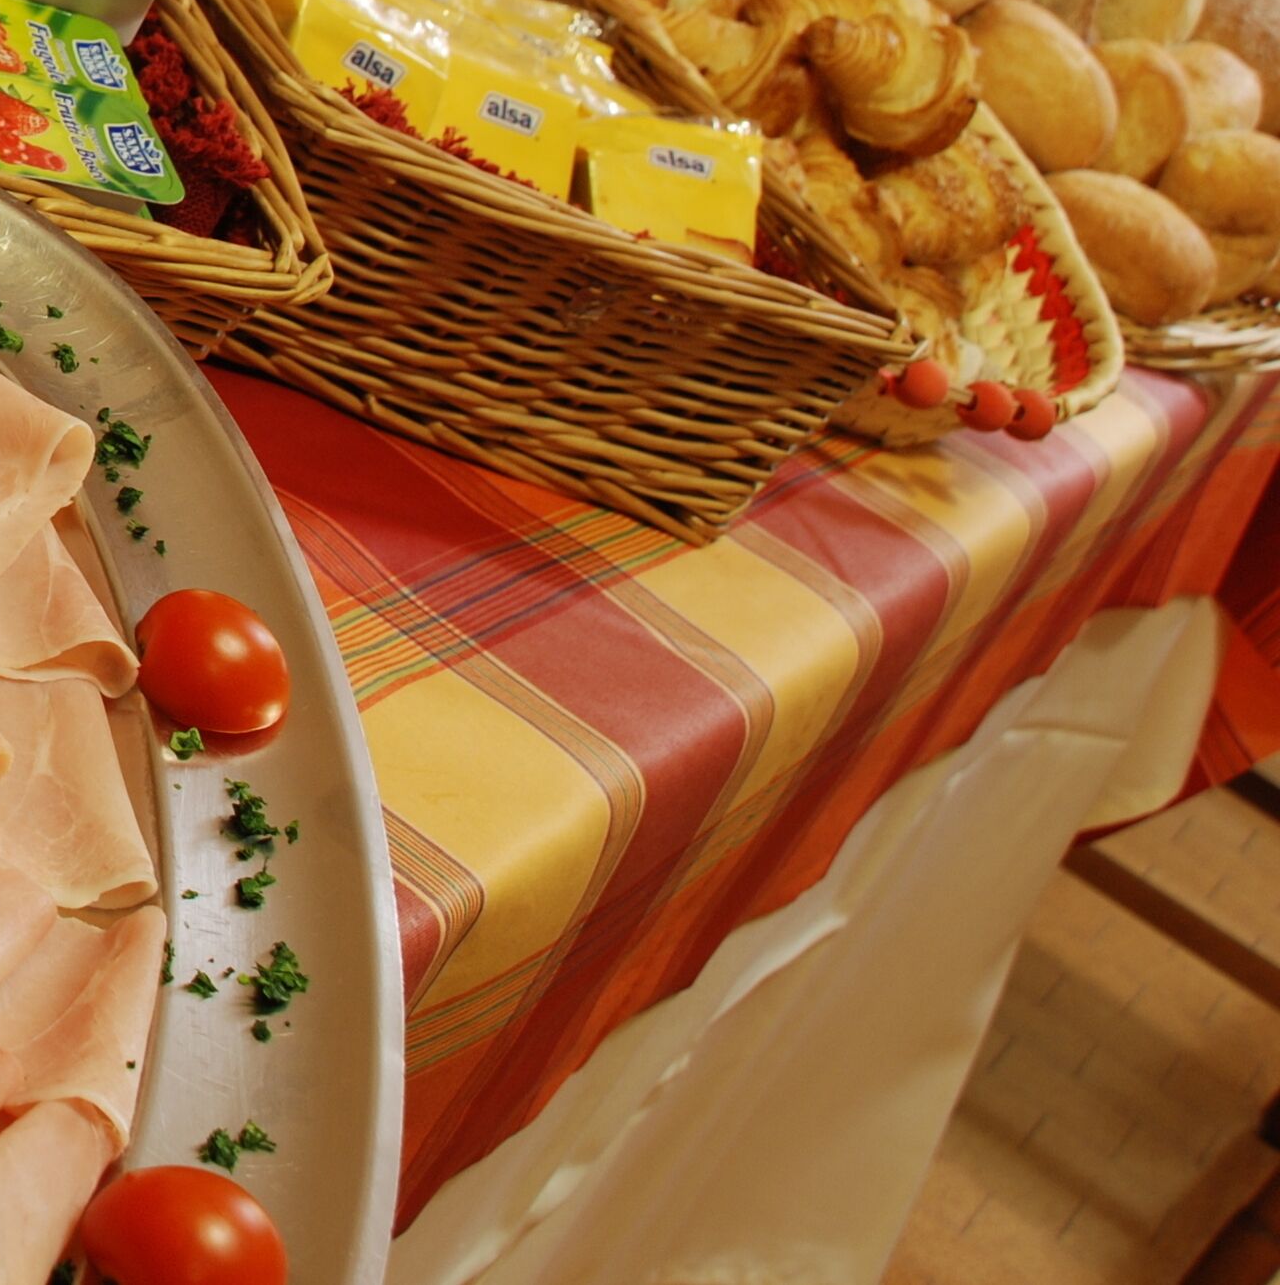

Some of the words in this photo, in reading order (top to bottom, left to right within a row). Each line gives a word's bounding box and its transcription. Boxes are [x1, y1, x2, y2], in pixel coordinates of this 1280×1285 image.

[27, 21, 66, 85] Fragole
[78, 47, 101, 80] ROSA
[90, 44, 115, 84] SANTA
[350, 45, 395, 85] alsa
[487, 98, 533, 131] alsa
[54, 92, 85, 137] Frutti
[76, 147, 108, 184] Bosco
[111, 131, 136, 167] ROSA
[122, 128, 150, 171] SANTA
[655, 151, 705, 174] alsa
